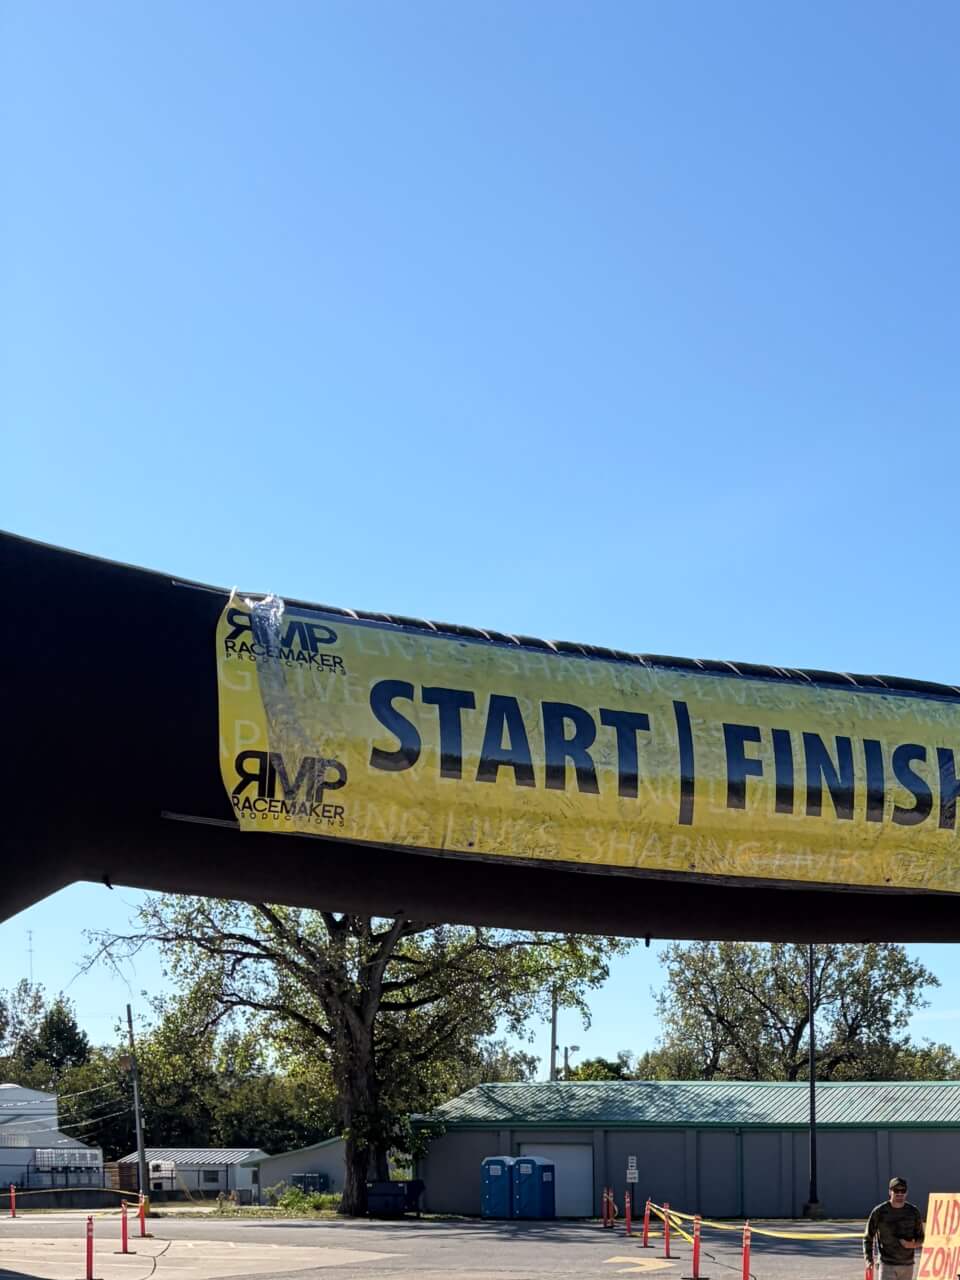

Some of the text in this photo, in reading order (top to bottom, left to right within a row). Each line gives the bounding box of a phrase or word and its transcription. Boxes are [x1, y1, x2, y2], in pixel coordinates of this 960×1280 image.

[225, 640, 345, 669] RACEMAKER
[369, 679, 651, 798] START
[232, 795, 345, 820] RACEMAKER
[930, 1199, 960, 1236] KID
